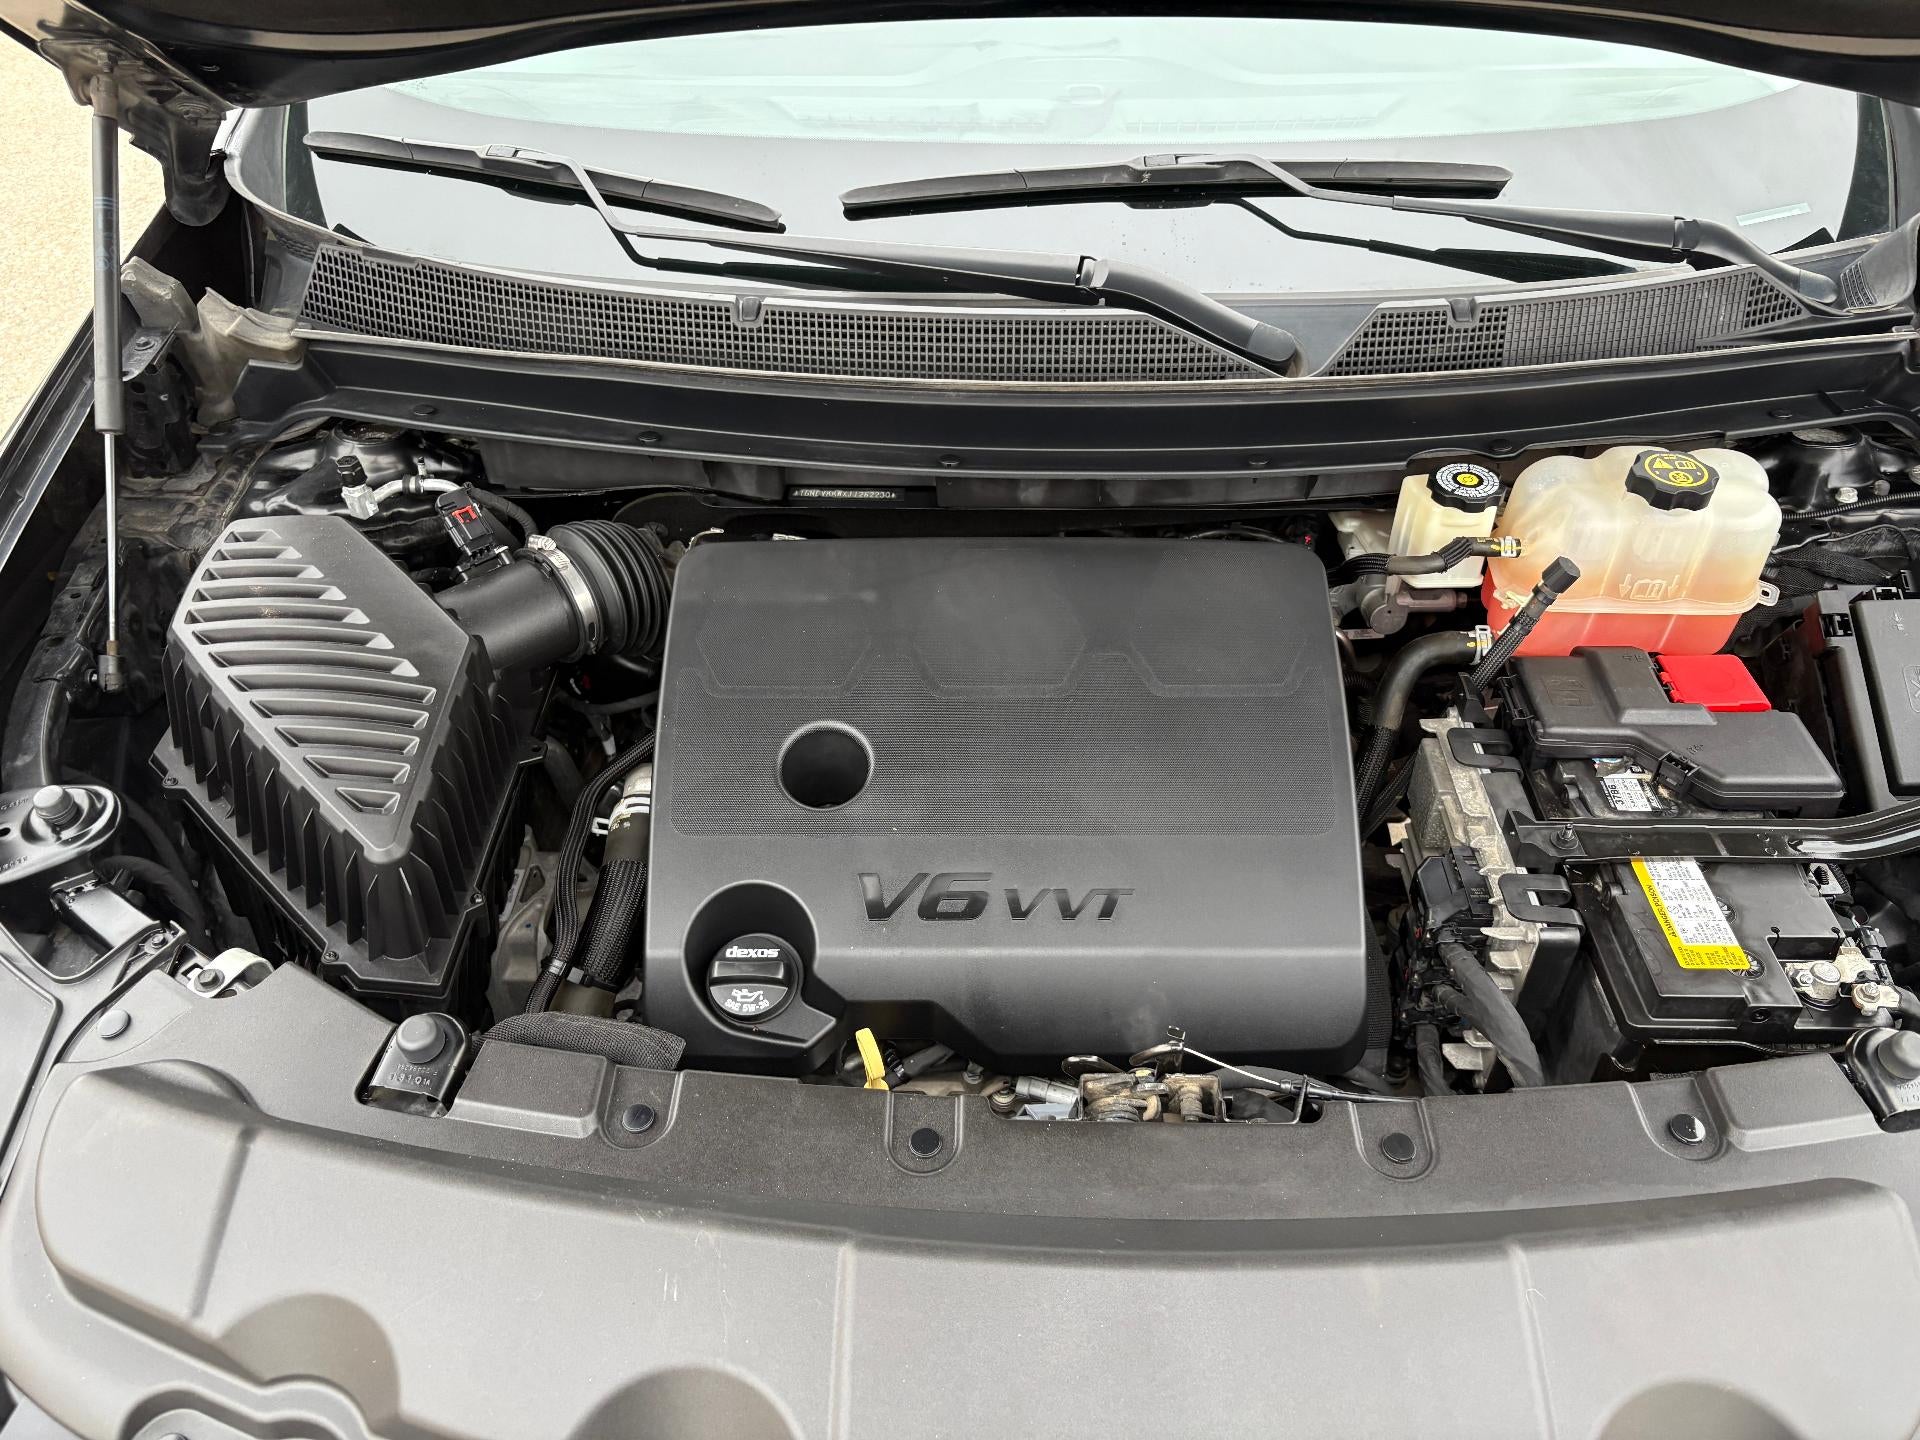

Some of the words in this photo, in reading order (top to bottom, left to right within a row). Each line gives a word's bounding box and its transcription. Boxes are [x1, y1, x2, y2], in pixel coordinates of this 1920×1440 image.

[857, 872, 993, 922] V6
[1003, 887, 1136, 921] VVT
[725, 945, 781, 958] dexos
[724, 999, 742, 1012] SAE
[742, 998, 770, 1012] 5W-30
